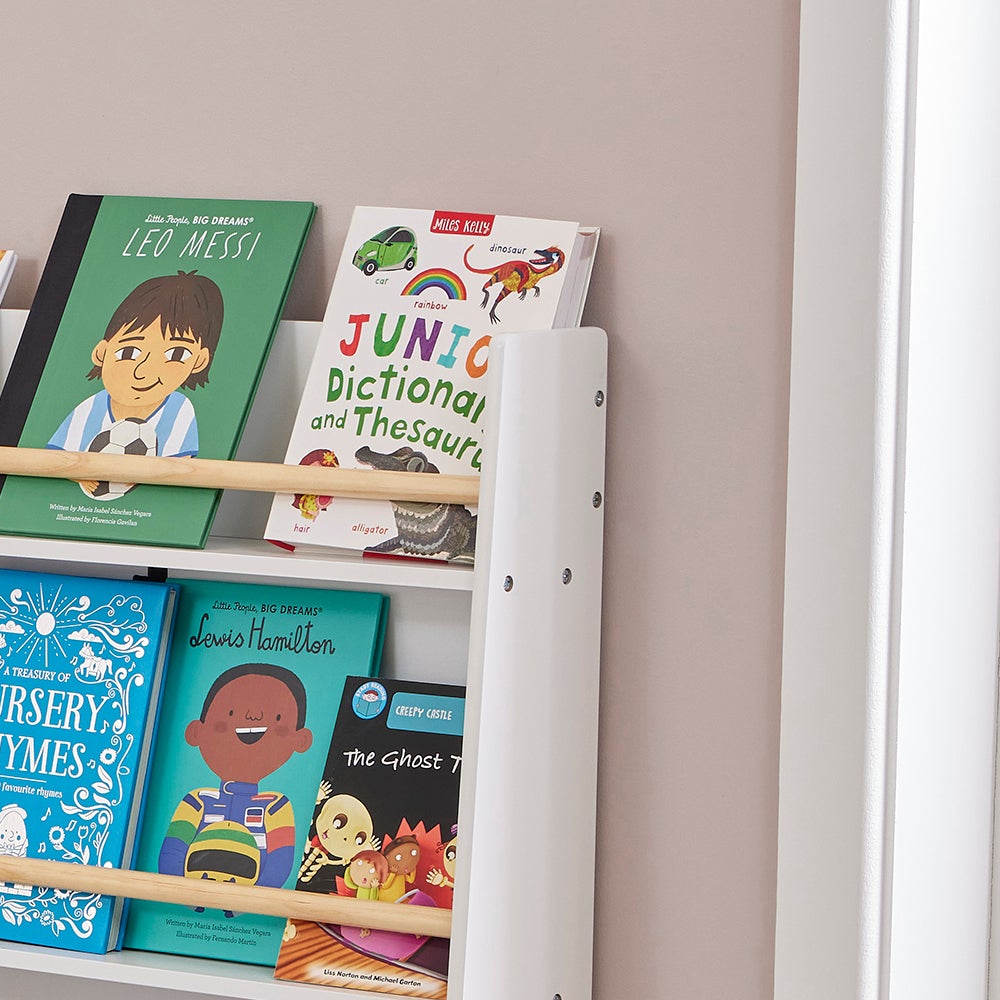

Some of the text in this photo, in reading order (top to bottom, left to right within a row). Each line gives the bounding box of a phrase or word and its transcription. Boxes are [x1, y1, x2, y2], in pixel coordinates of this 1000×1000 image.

[192, 216, 209, 225] BIG
[122, 227, 262, 261] LEO MESSI
[489, 243, 527, 255] dinosaur
[375, 277, 389, 285] car
[413, 299, 448, 311] rainbow
[311, 409, 348, 430] and
[294, 523, 310, 534] hair
[351, 523, 389, 535] alligator
[261, 604, 277, 613] BIG
[189, 612, 336, 655] Lewis Hamilton
[3, 667, 72, 682] A TREASURY OF
[395, 704, 453, 721] CREEPY CASTLE
[343, 748, 376, 767] The
[381, 748, 444, 771] Ghost
[1, 781, 36, 795] favourite
[36, 788, 64, 799] rhymes
[336, 970, 359, 979] Norton
[372, 975, 399, 984] Michael
